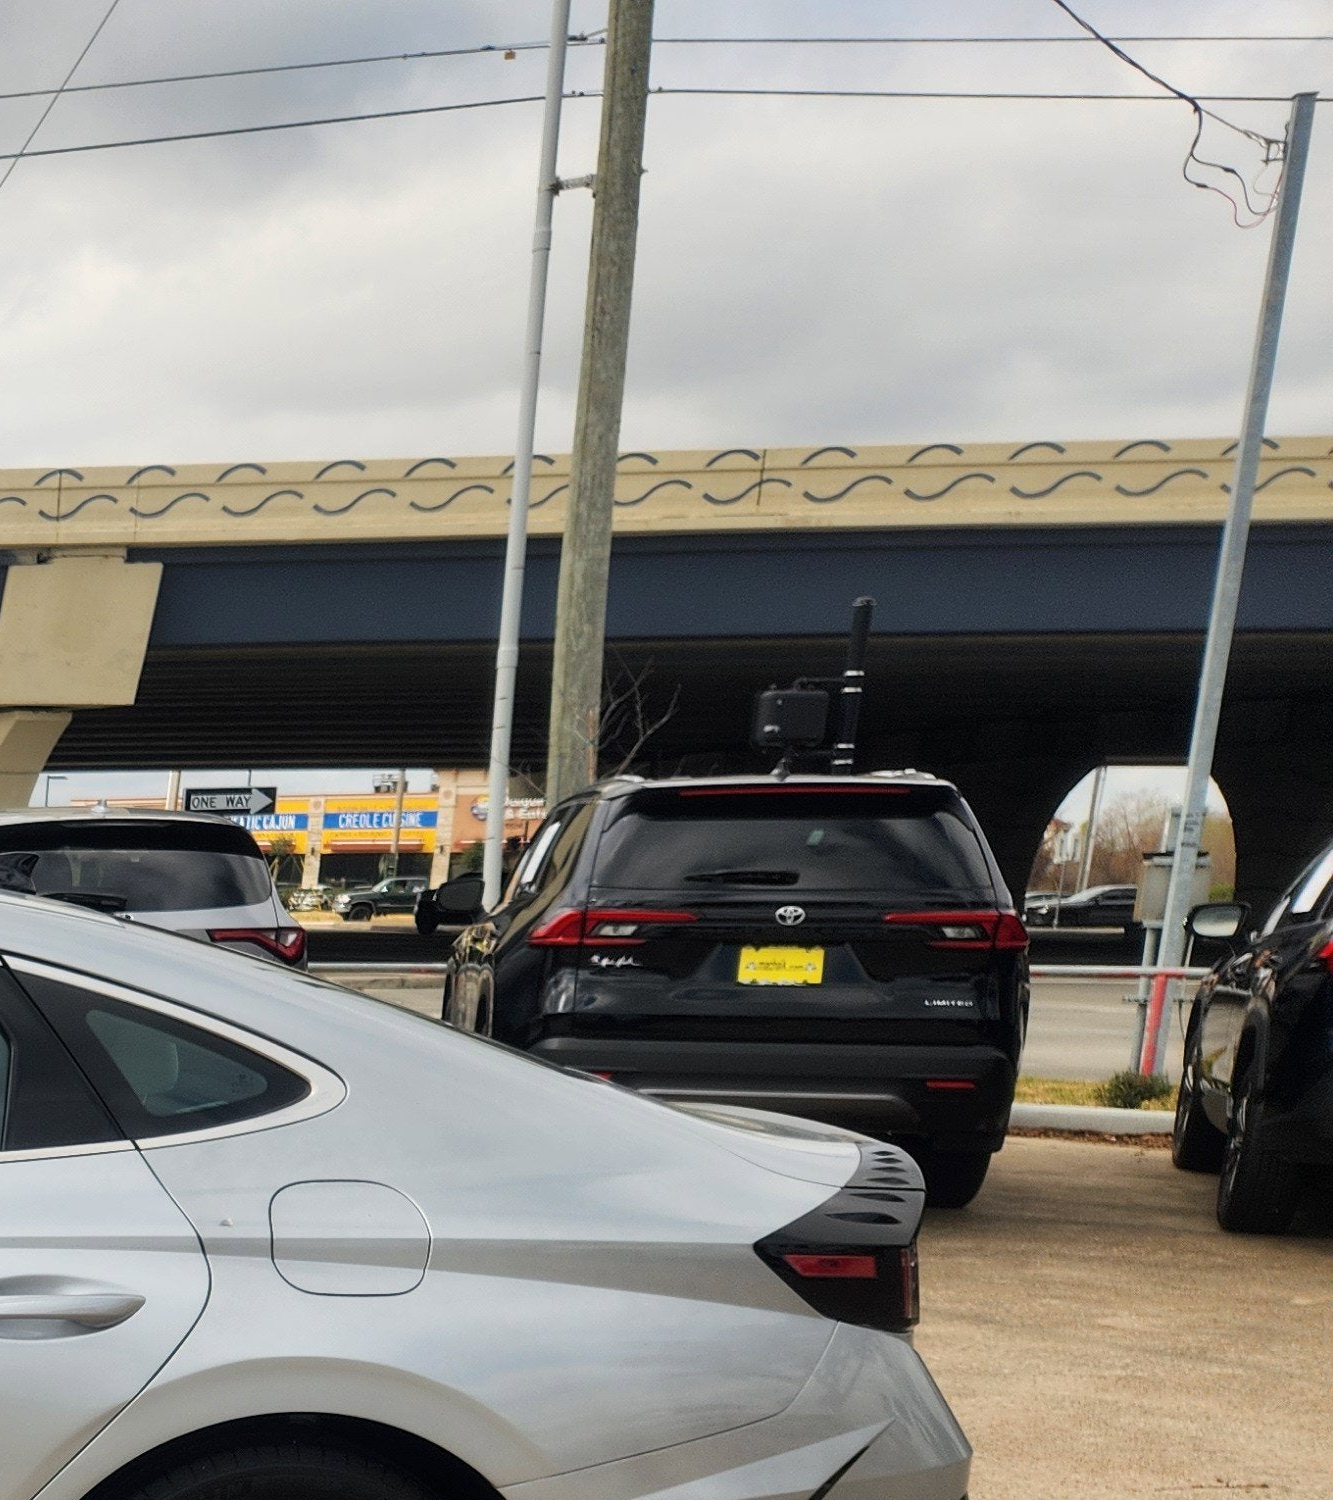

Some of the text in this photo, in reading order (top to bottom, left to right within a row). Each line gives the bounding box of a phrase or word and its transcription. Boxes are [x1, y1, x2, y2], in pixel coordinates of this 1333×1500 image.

[191, 796, 251, 809] ONE WAY
[262, 813, 296, 831] CAJUN
[338, 812, 381, 829] CREOLE
